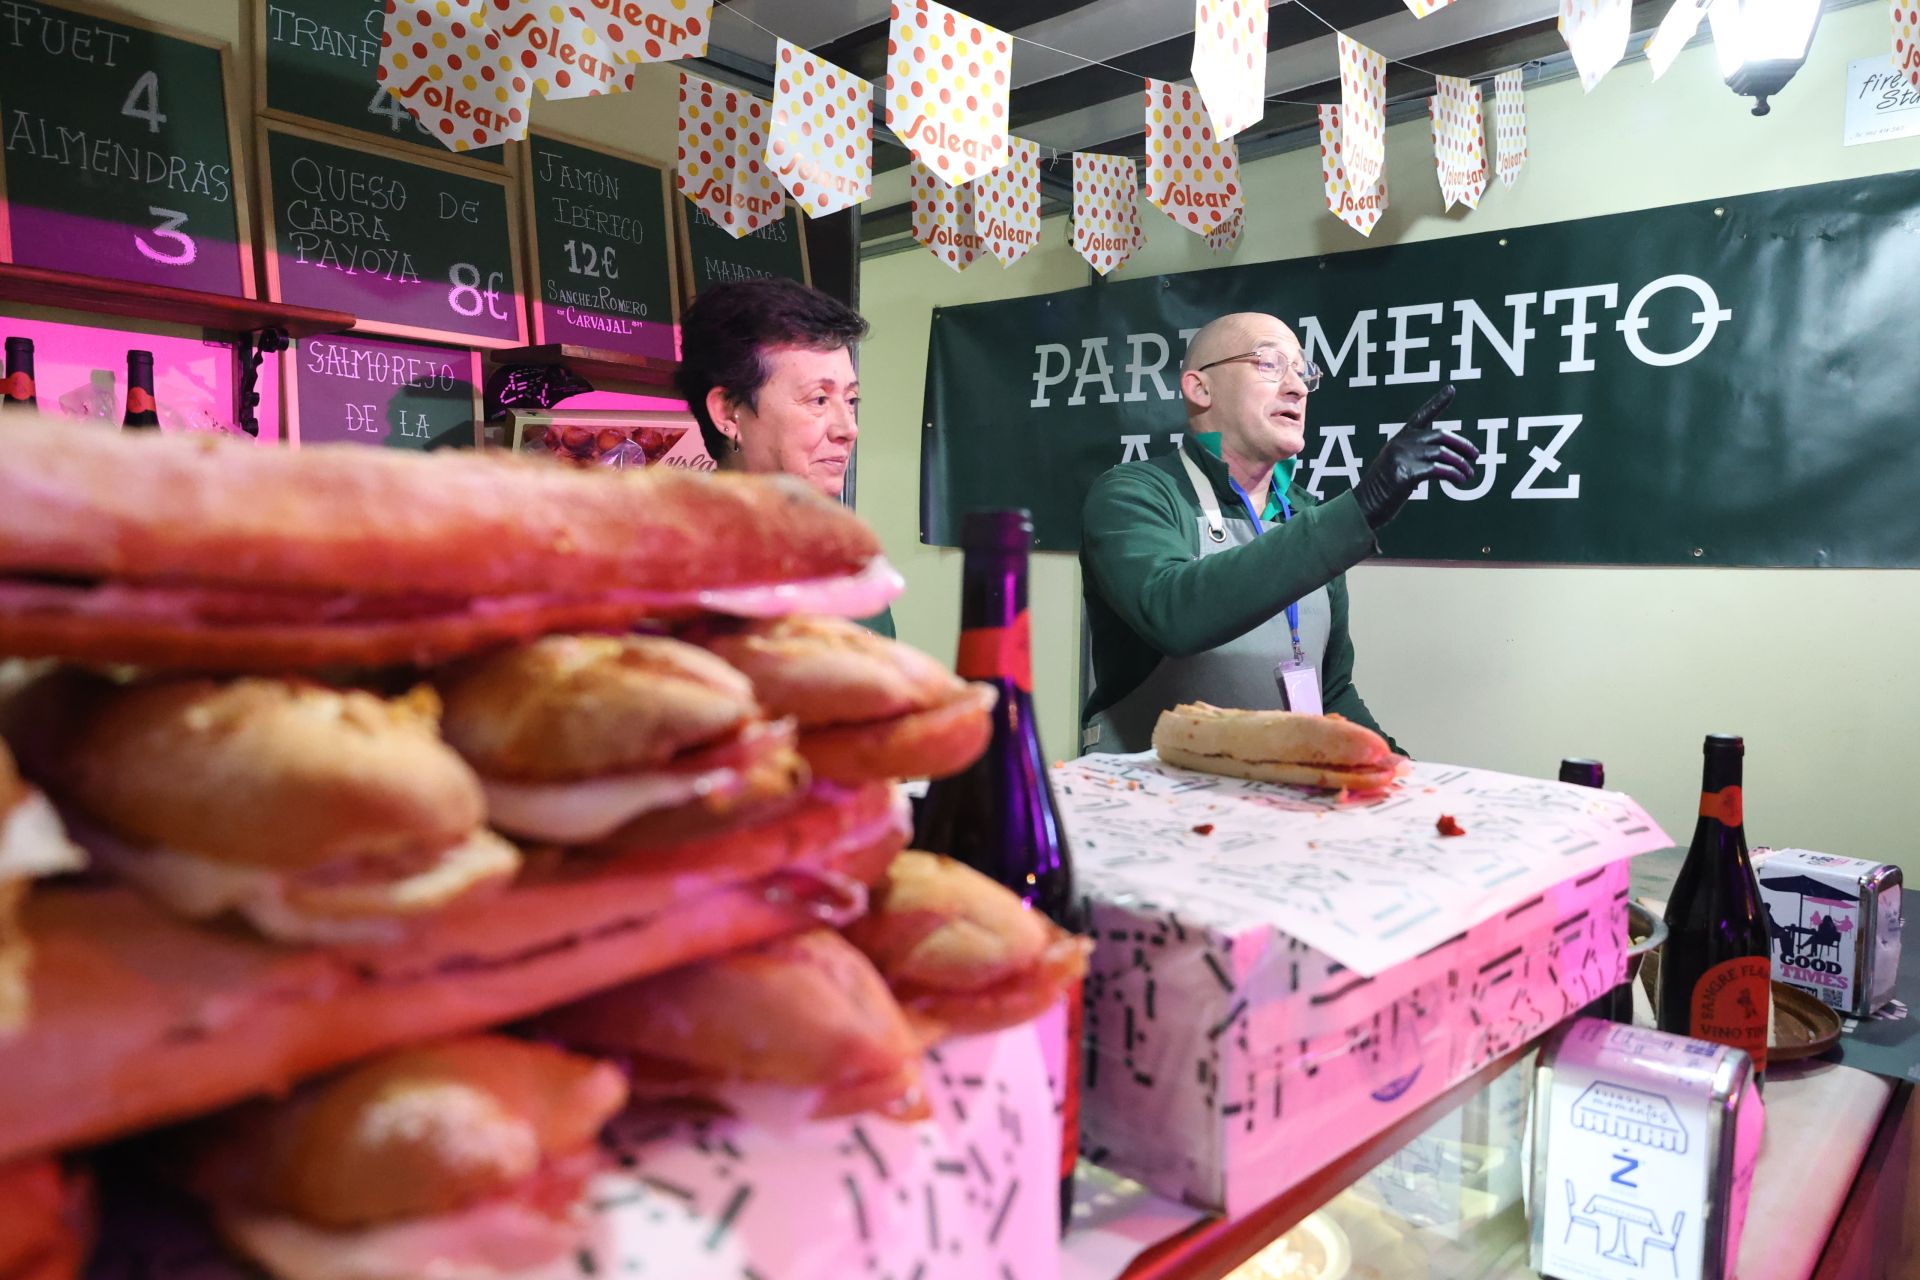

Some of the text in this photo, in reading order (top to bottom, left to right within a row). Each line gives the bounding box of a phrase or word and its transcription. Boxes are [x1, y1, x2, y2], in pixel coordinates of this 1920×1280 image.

[3, 2, 130, 67] FUET
[269, 4, 379, 67] TRANF
[589, 0, 687, 46] lear
[502, 13, 616, 83] Solear
[121, 70, 168, 133] 4
[400, 75, 511, 133] Solear
[6, 109, 230, 202] ALMENDRAS
[904, 114, 993, 163] Solear
[1348, 144, 1378, 176] Solear
[291, 157, 480, 224] QUESO DE
[779, 153, 859, 196] Solear
[1160, 182, 1231, 208] Solear
[694, 178, 773, 216] Solear
[134, 206, 198, 266] 3
[287, 200, 391, 242] CABRA
[925, 224, 983, 249] Solear
[985, 217, 1033, 245] Solear
[1083, 232, 1128, 252] Solear
[289, 232, 421, 283] PAYOYA
[564, 239, 619, 280] 12€
[448, 262, 508, 321] 8€
[566, 305, 632, 335] CARVAJAL
[1030, 274, 1732, 408] PARMENTO
[307, 341, 455, 392] SALMOREJO
[345, 403, 431, 439] DE LA
[1779, 953, 1842, 975] GOOD
[1780, 964, 1849, 990] TIMES
[1701, 1023, 1742, 1039] VINO
